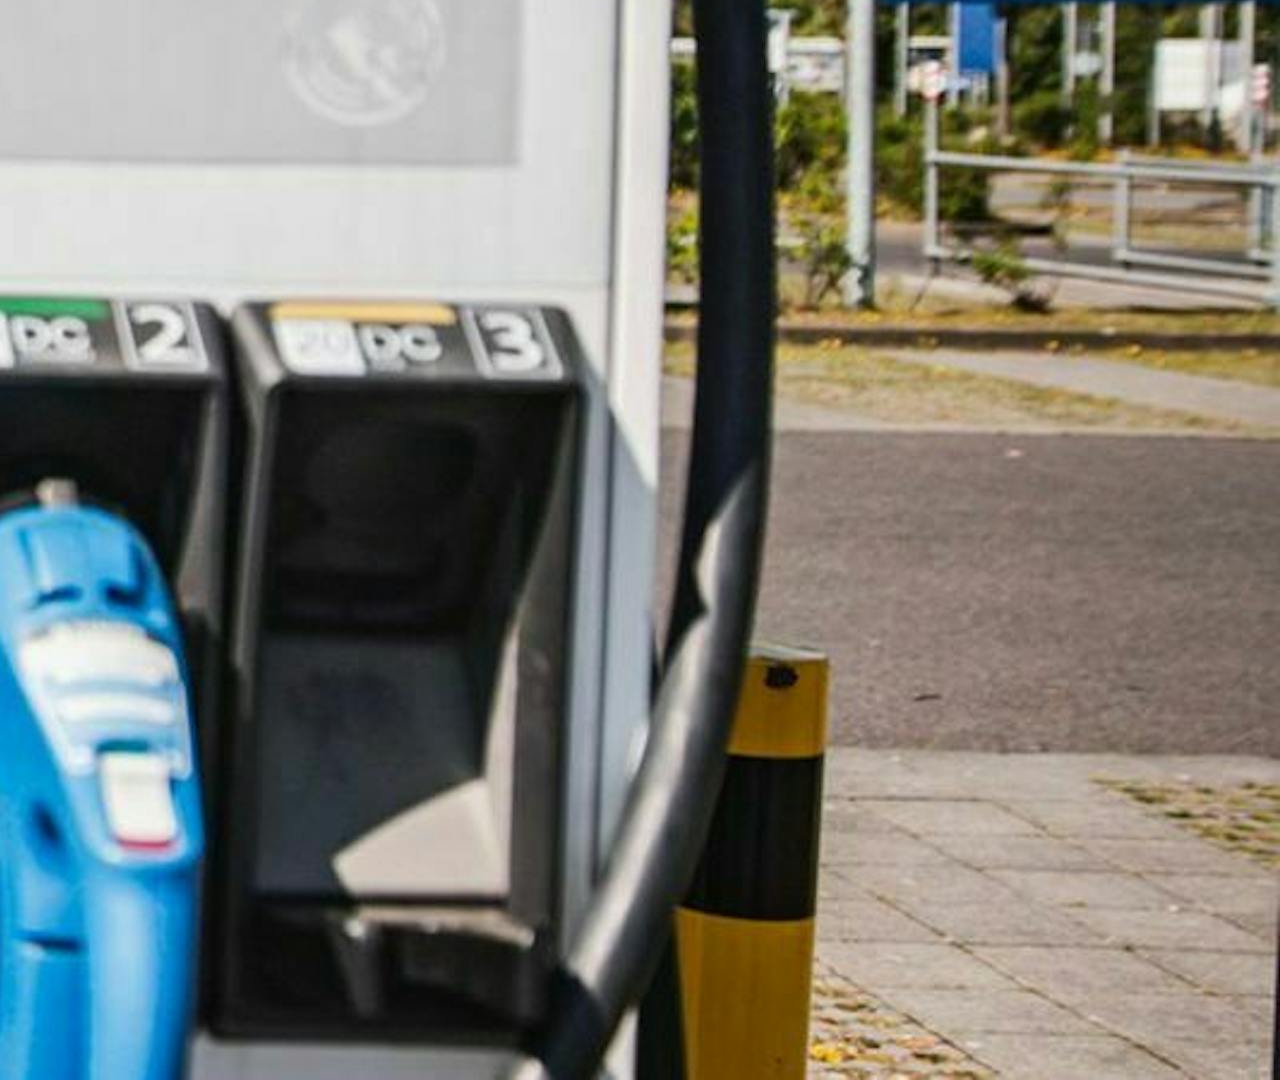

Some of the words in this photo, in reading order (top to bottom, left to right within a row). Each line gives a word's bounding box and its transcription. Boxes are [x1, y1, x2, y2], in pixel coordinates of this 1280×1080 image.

[132, 302, 192, 362] 2
[360, 323, 443, 363] DC
[481, 310, 546, 370] 3
